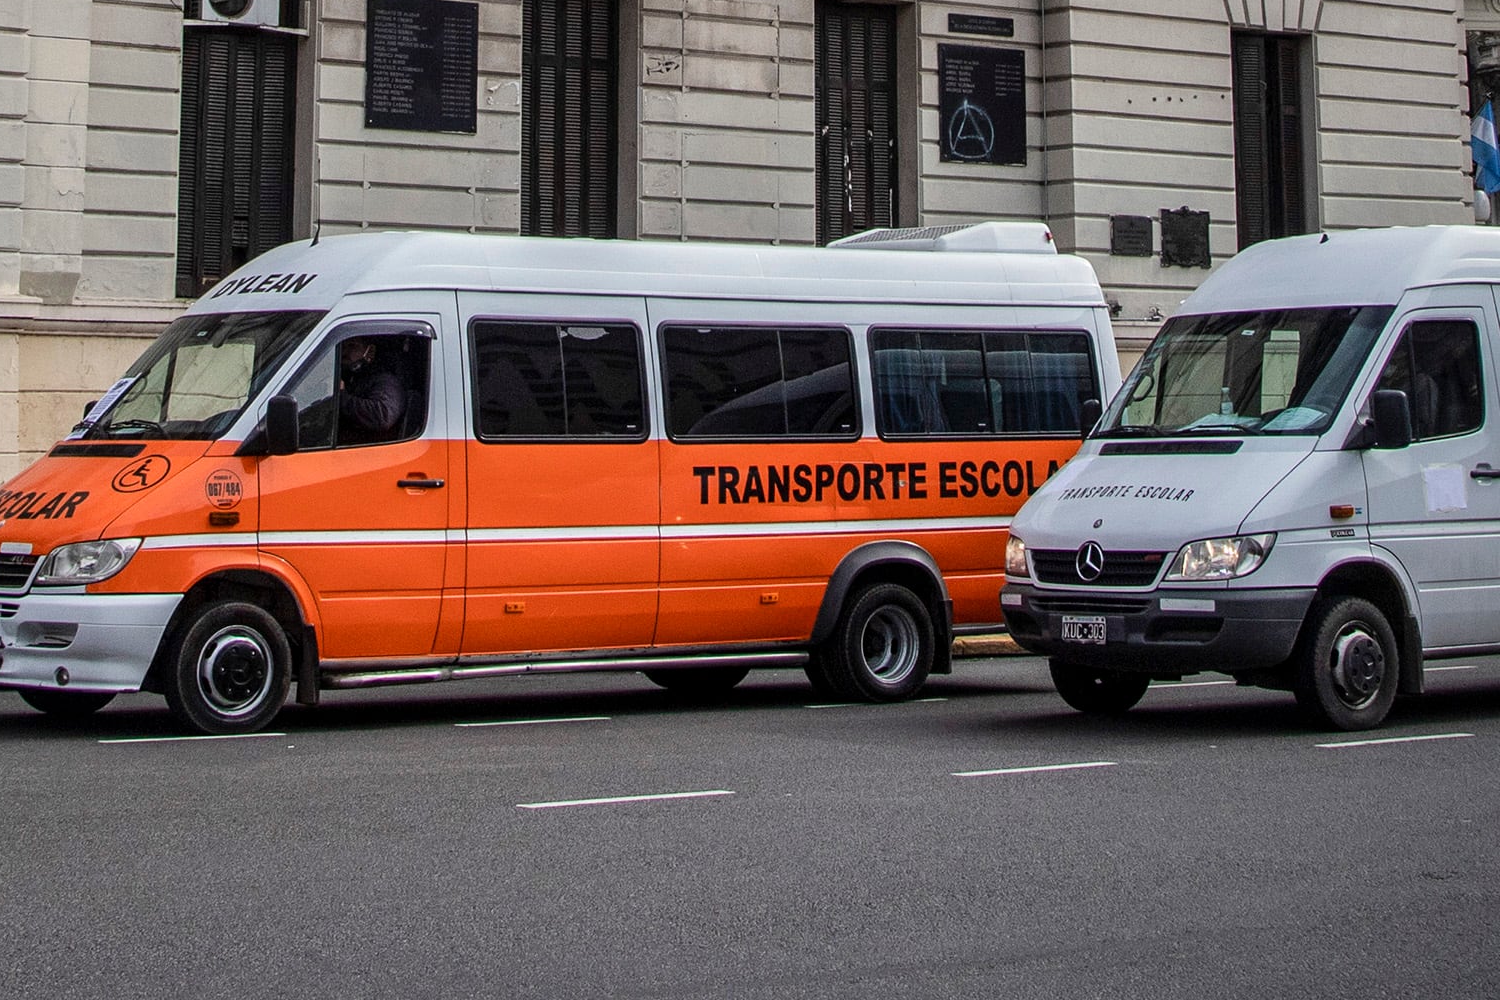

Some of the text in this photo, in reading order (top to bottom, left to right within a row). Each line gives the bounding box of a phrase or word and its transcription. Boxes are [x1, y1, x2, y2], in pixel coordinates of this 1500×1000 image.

[209, 273, 319, 300] DYLEAN
[692, 460, 1070, 505] TRANSPORTE ESCOL
[1057, 485, 1196, 502] TRANSPORTE ESCOLAR
